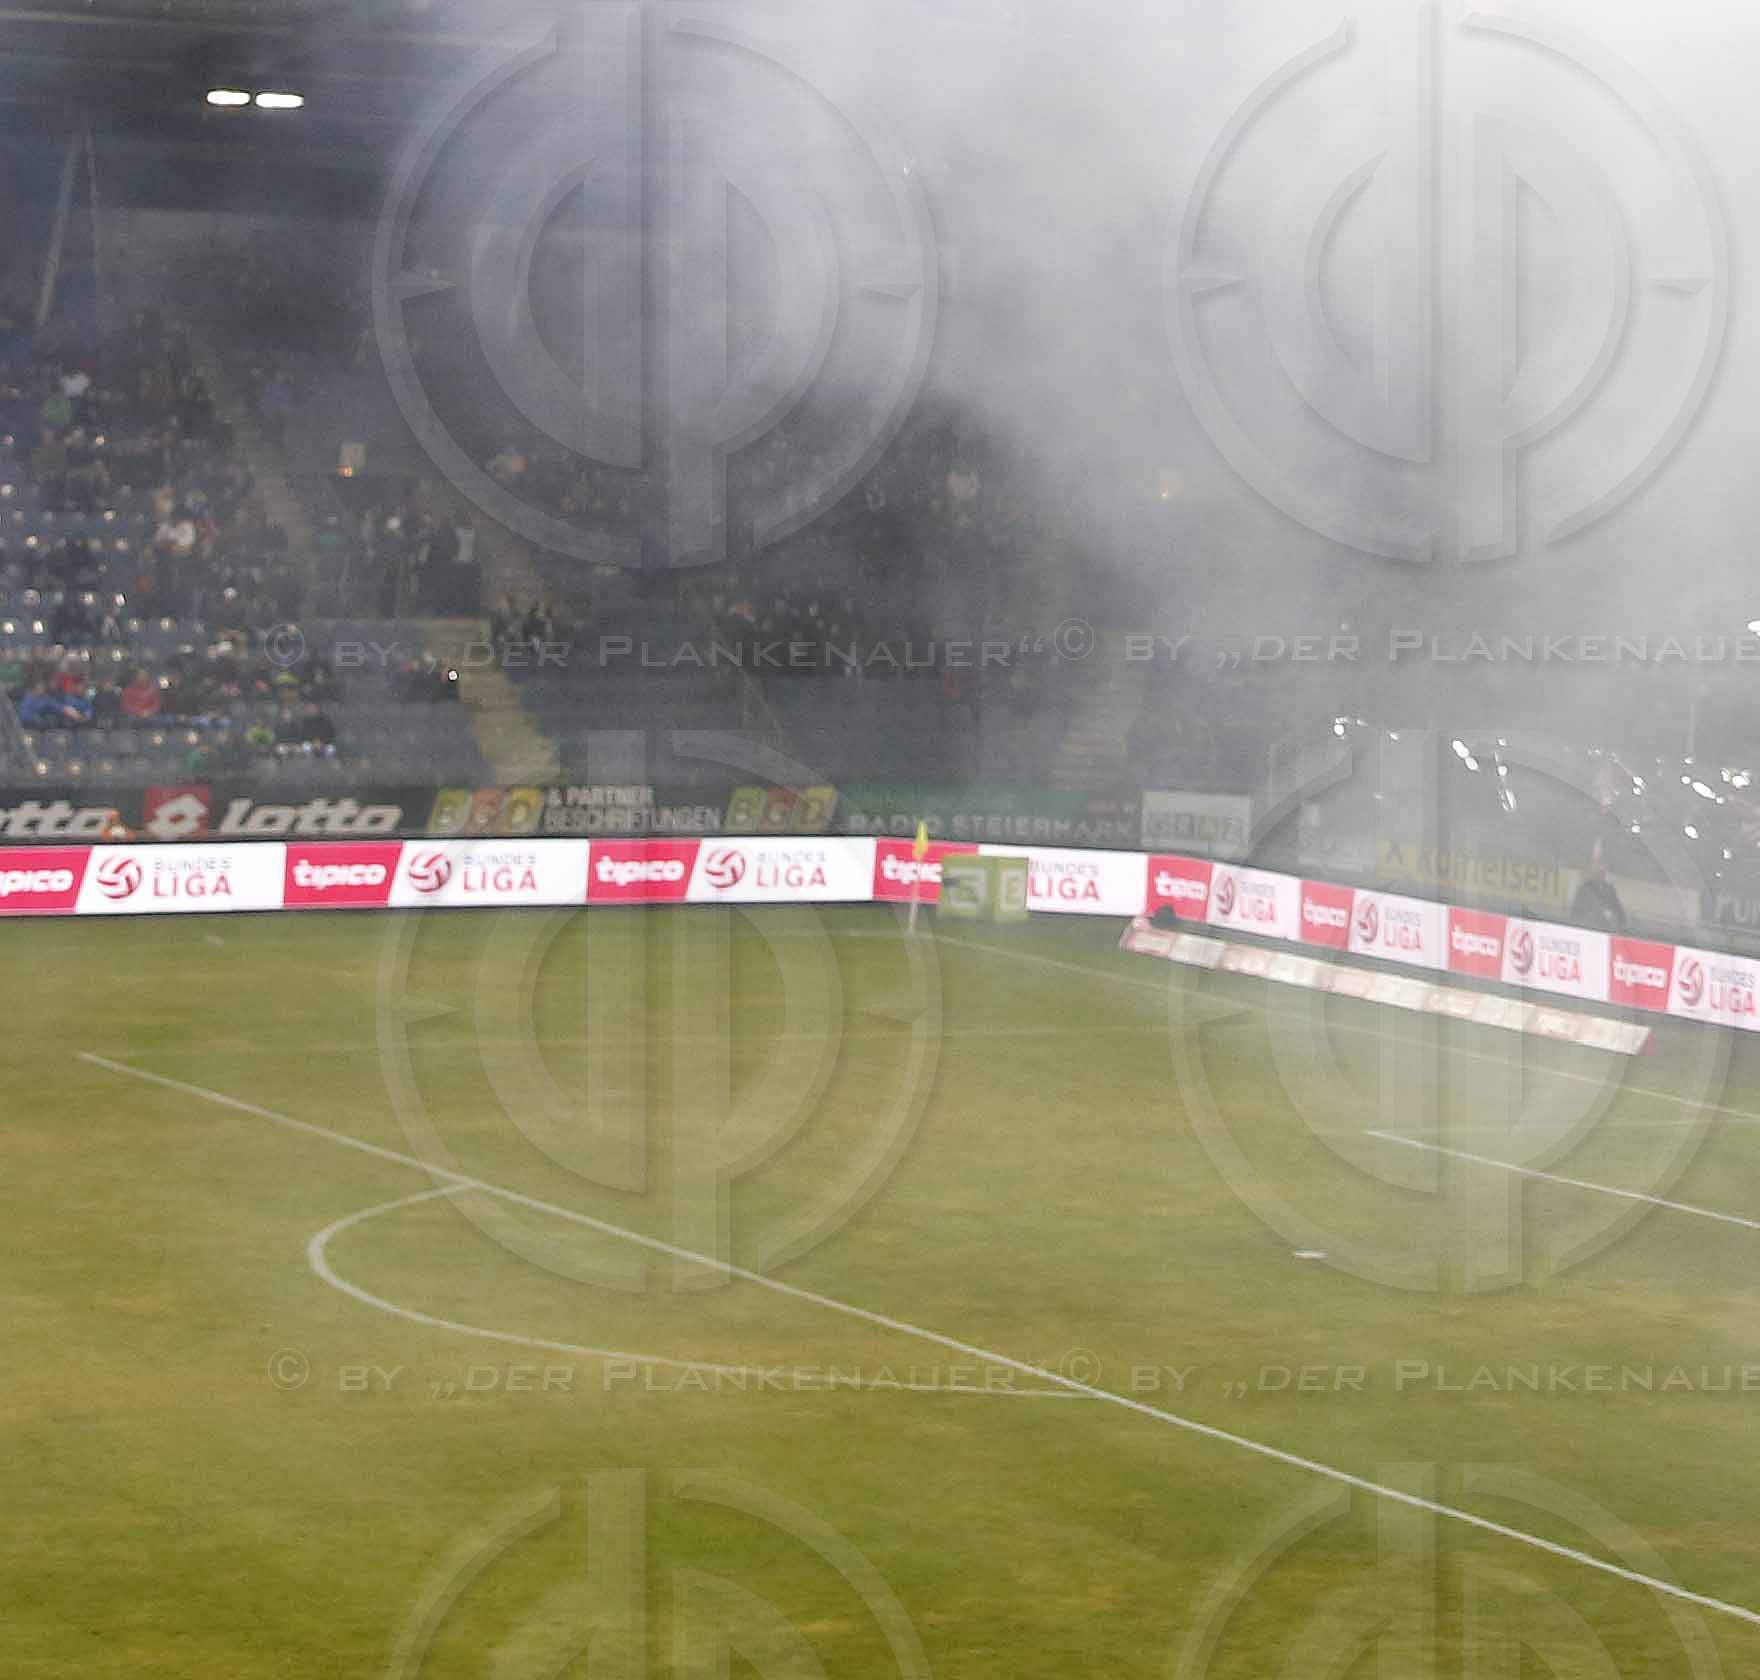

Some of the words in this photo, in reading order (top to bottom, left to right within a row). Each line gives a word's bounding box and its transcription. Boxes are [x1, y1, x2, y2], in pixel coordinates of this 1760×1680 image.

[218, 799, 403, 834] lotto
[153, 874, 232, 897] LIGA
[293, 860, 387, 891] tipico
[463, 869, 537, 891] LIGA
[756, 865, 828, 888] LIGA
[1029, 876, 1101, 901] LIGA
